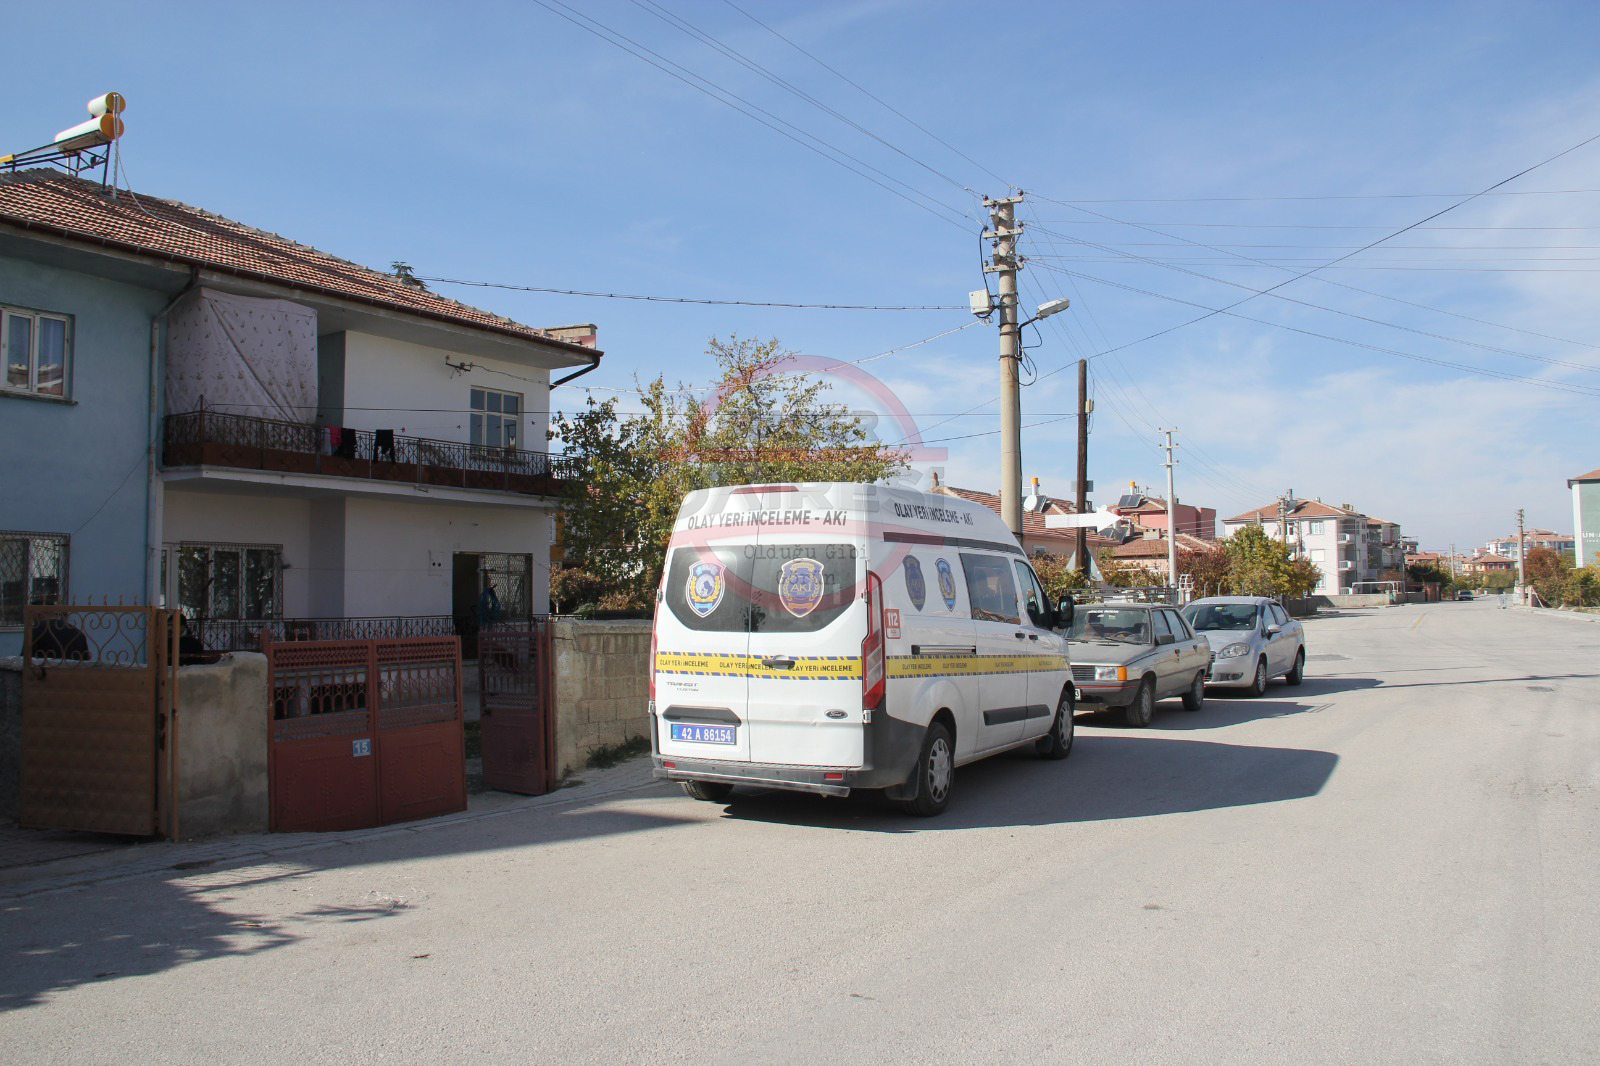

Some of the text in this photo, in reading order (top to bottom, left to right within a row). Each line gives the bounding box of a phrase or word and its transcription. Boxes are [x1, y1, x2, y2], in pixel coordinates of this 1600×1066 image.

[894, 502, 913, 518] OLAY
[687, 514, 715, 530] OLAY
[887, 612, 899, 627] 112
[681, 727, 731, 742] 42 A 86154
[355, 742, 368, 753] 15
